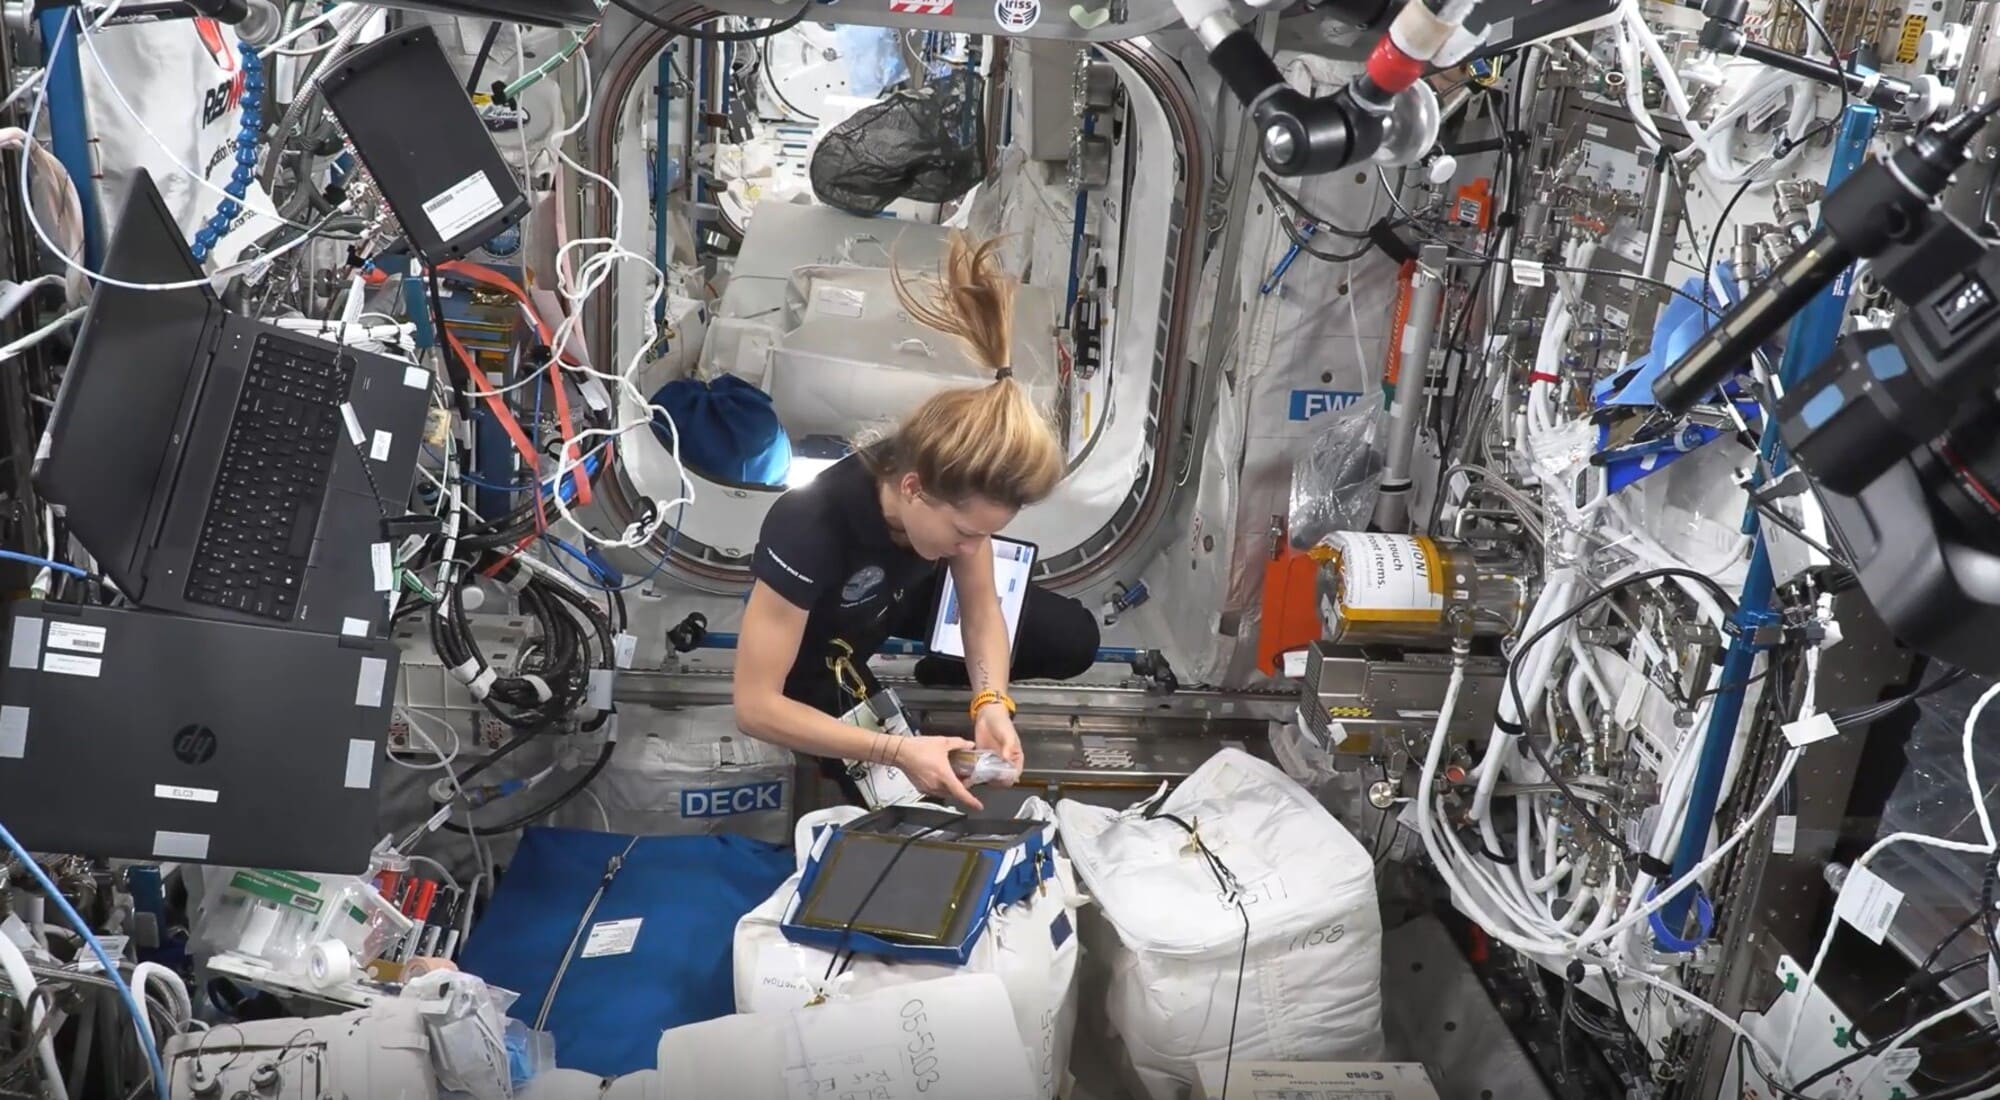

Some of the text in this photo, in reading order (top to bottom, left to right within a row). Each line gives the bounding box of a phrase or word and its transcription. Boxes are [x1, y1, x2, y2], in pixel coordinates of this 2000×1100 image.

[1305, 394, 1361, 418] FW
[1375, 553, 1386, 589] items.
[1388, 543, 1404, 571] touch
[686, 784, 778, 816] DECK
[900, 999, 940, 1093] 05-5103
